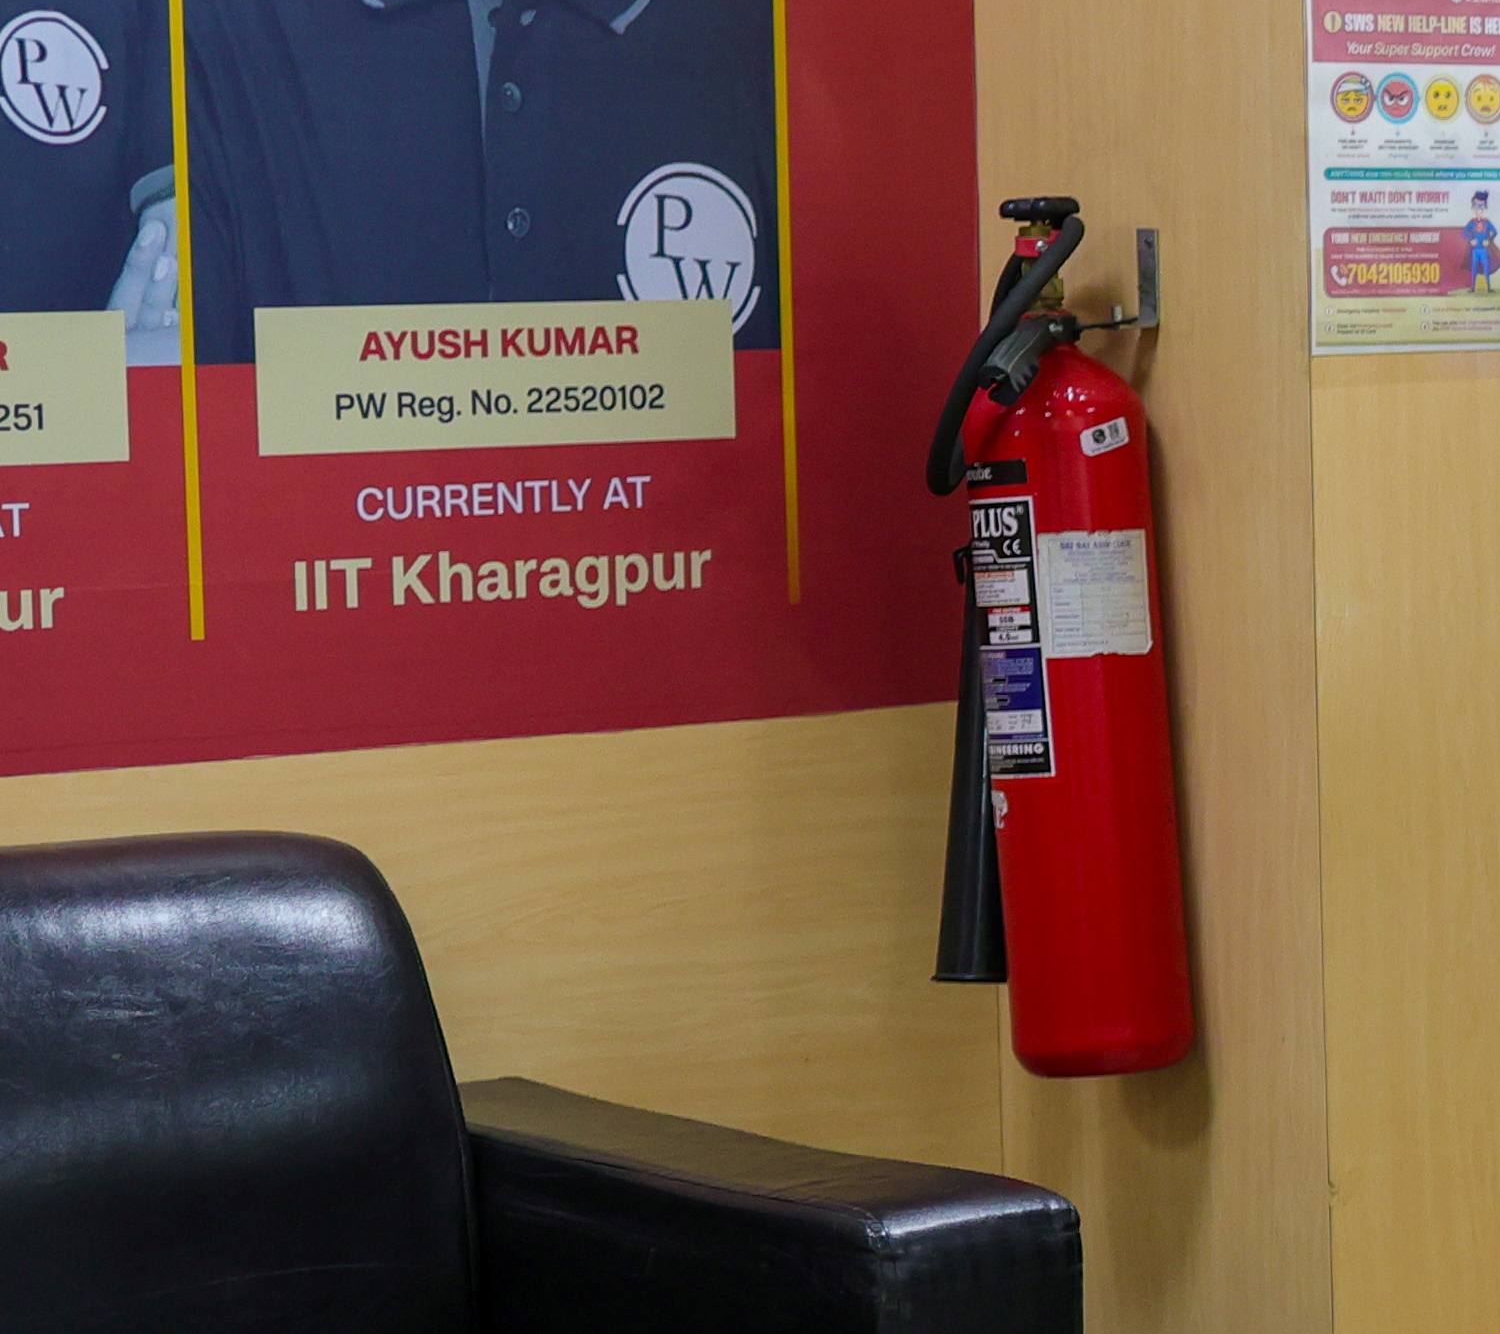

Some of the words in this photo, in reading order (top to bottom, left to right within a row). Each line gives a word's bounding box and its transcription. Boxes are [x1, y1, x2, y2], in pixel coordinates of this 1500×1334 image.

[1345, 14, 1374, 33] SWS
[360, 329, 489, 362] AYUSH
[500, 326, 638, 359] KUMAR
[335, 394, 386, 420] PW
[396, 391, 462, 424] Reg.
[471, 389, 518, 416] No.
[527, 385, 665, 415] 22520102
[356, 479, 592, 521] CURRENTLY
[602, 477, 651, 510] AT
[293, 556, 371, 612] IIT
[392, 548, 712, 608] Kharagpur
